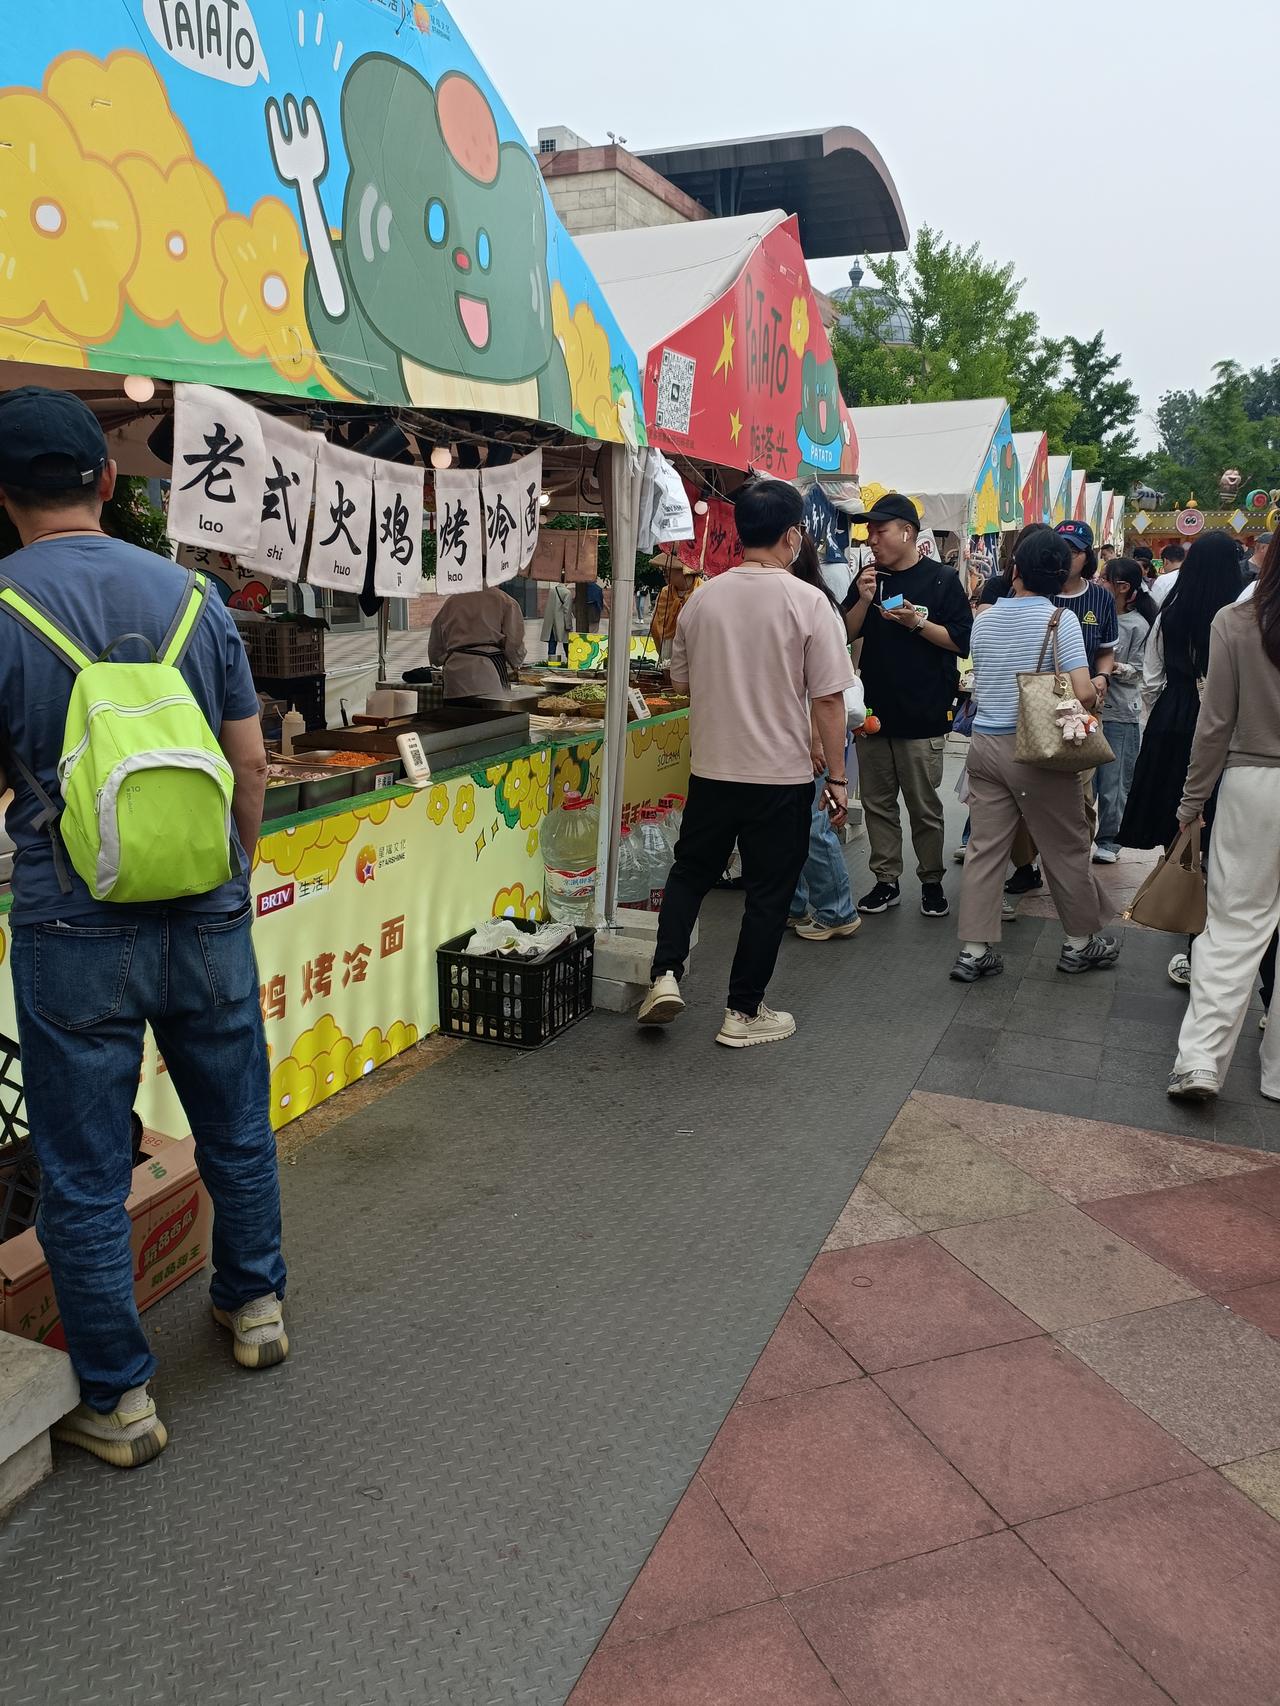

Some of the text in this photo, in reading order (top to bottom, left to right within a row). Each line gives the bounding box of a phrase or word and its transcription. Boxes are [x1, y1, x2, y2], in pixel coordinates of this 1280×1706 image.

[745, 272, 789, 399] PATATO
[810, 444, 833, 463] PATATO
[198, 514, 224, 533] lao
[266, 545, 284, 561] shi
[333, 560, 351, 576] huo
[447, 571, 463, 582] kao
[299, 874, 325, 898] 生活
[261, 887, 291, 912] BRTV
